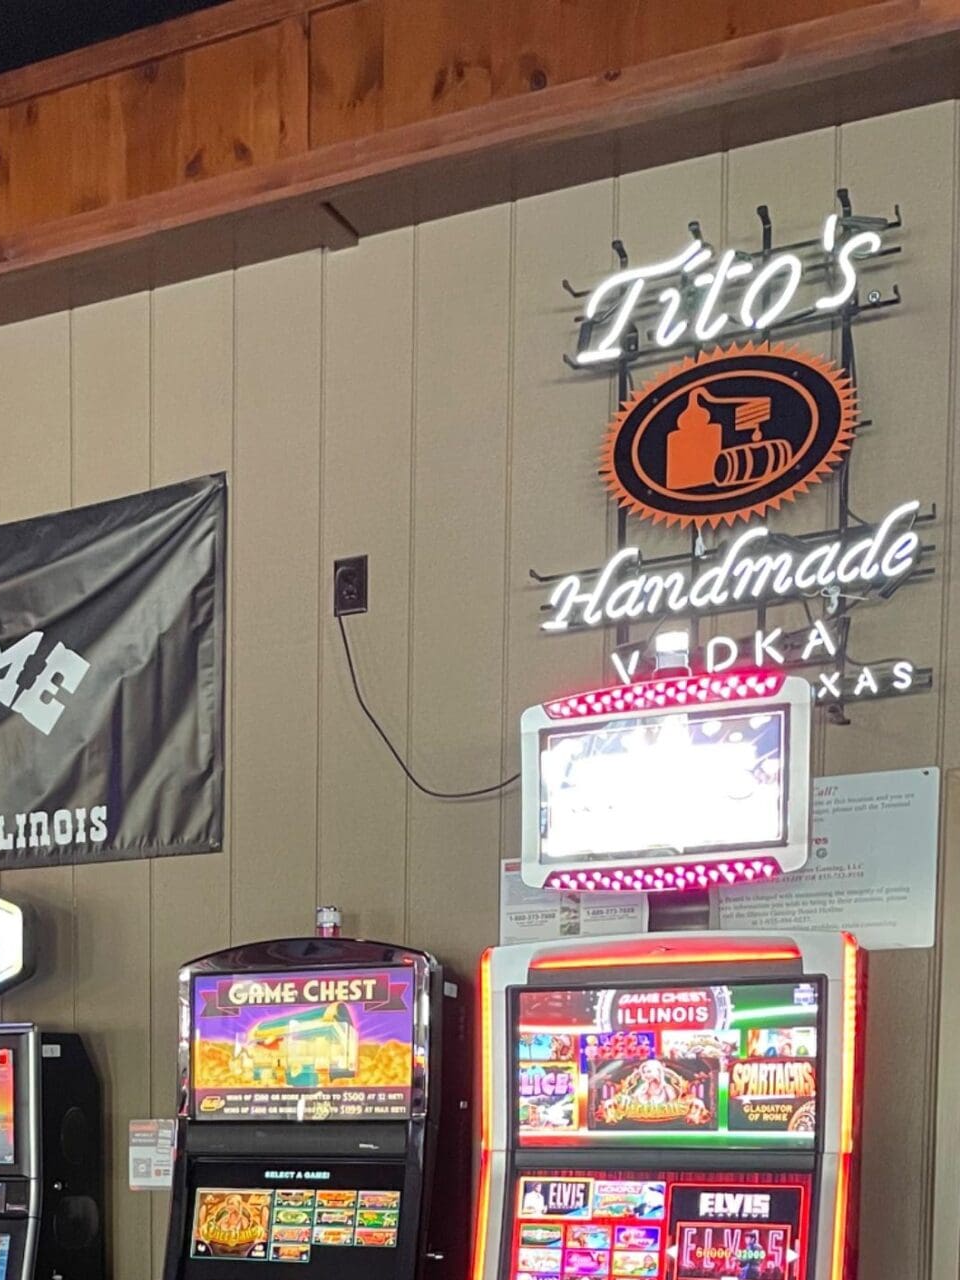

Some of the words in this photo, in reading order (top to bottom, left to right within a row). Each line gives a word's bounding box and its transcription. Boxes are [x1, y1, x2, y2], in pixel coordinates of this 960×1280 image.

[577, 214, 882, 364] Tito's
[541, 501, 919, 629] Handmade
[611, 621, 836, 684] VDKA
[818, 662, 914, 698] XAS
[228, 982, 298, 1005] GAME
[302, 979, 377, 1003] CHEST
[617, 1005, 709, 1025] ILLINOIS
[519, 1071, 573, 1097] LICE
[730, 1061, 816, 1098] SPARTACUS
[342, 1092, 365, 1103] $500
[743, 1103, 794, 1113] GLADIATOR
[264, 1171, 295, 1180] SELECT
[548, 1182, 586, 1209] ELVIS
[699, 1192, 771, 1214] ELVIS
